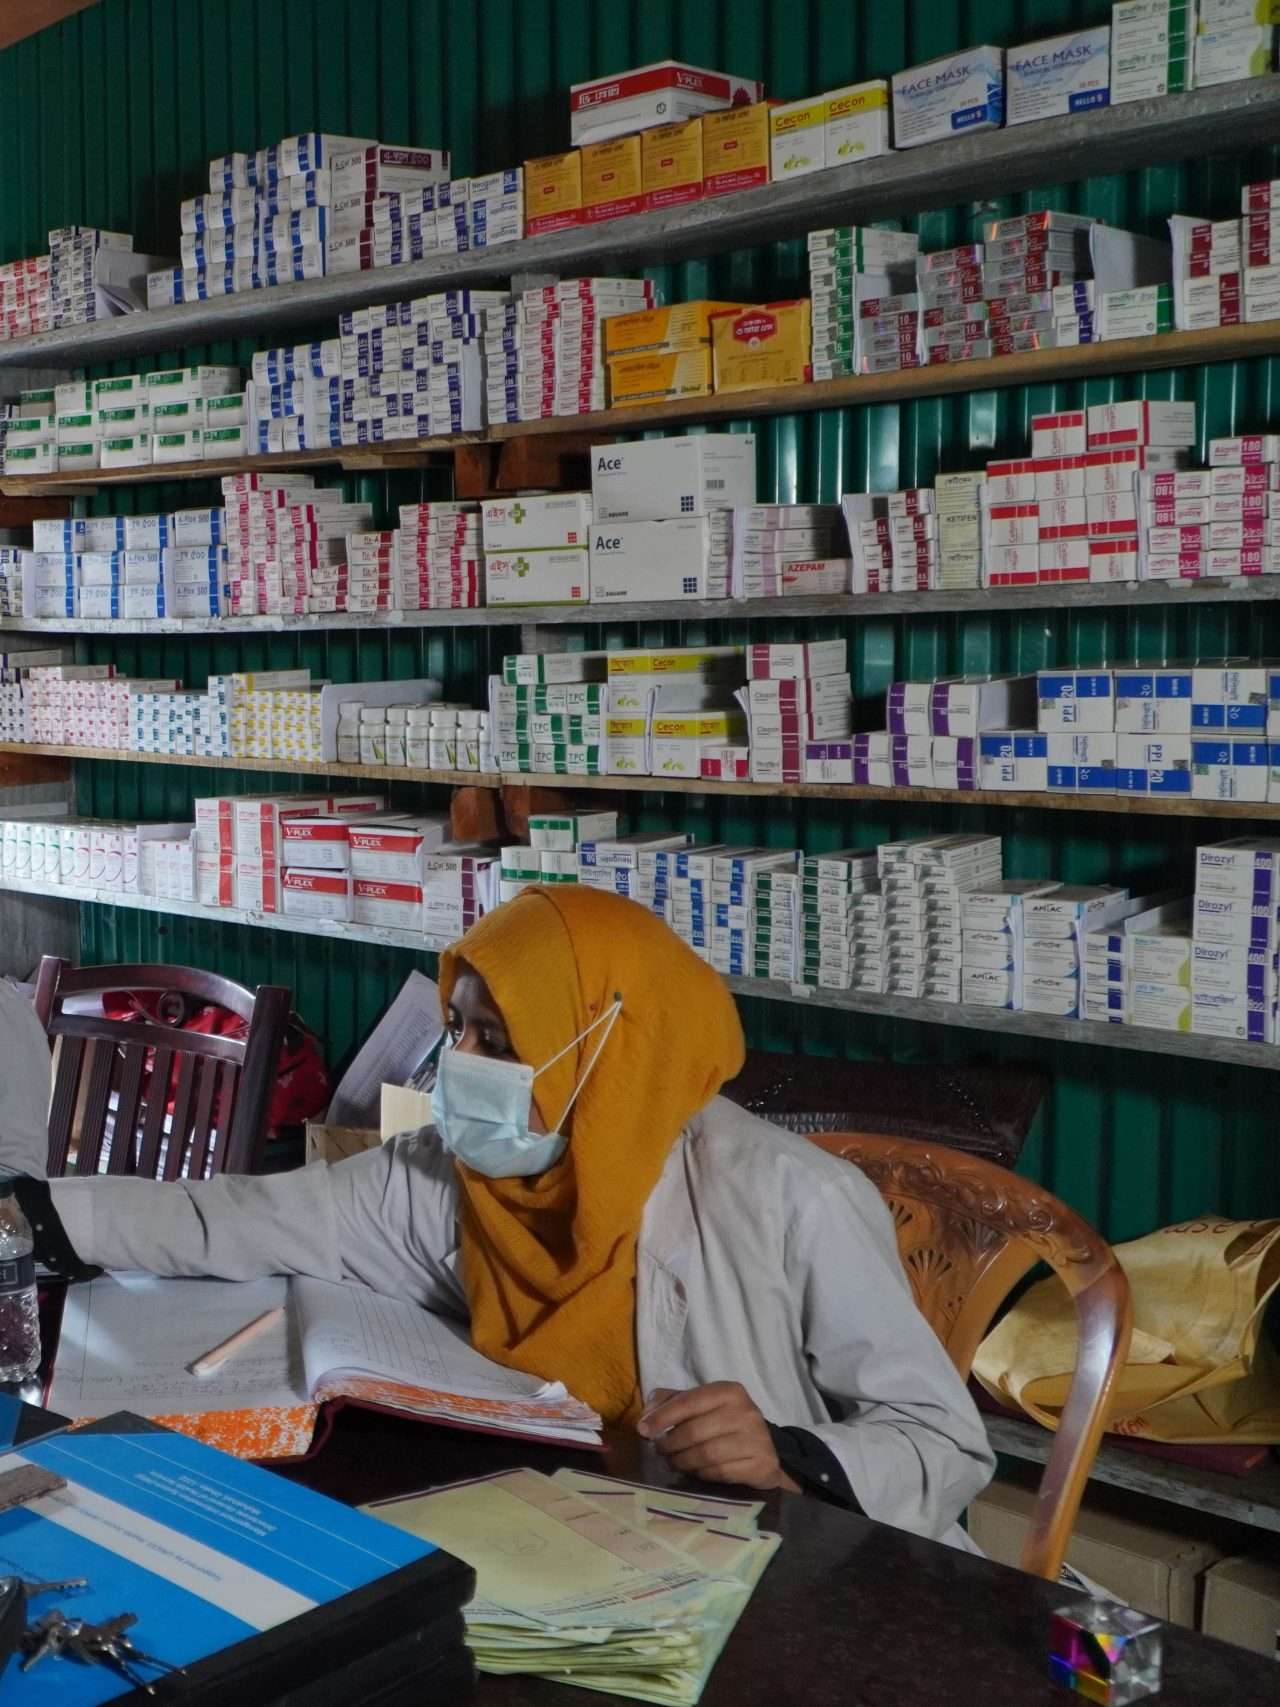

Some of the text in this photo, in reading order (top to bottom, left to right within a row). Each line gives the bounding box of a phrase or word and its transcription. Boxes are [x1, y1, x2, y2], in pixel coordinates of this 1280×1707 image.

[1016, 44, 1092, 72] FACE MASK
[902, 66, 970, 94] FACE MASK
[829, 95, 866, 113] Cecon
[775, 112, 811, 128] Cecon
[598, 457, 621, 472] Ace
[596, 536, 621, 550] Ace
[788, 563, 825, 573] AZEPAM
[568, 693, 585, 703] TPC
[1061, 685, 1074, 723] PPI 20
[533, 723, 549, 732] TPC
[656, 722, 686, 732] Cecon
[501, 751, 516, 761] TPC
[536, 751, 552, 761] TPC
[568, 752, 585, 761] TPC
[1000, 745, 1013, 782] PPI 20
[1151, 744, 1165, 783] PPI 20
[286, 827, 313, 837] V-PLEX
[353, 836, 383, 848] V-PLEX
[1200, 852, 1235, 865] Dirozyl
[287, 877, 313, 888] V-PLEX
[358, 883, 387, 896] V-PLEX
[1198, 900, 1233, 912] Dirozyl
[1194, 947, 1229, 960] Dirozyl
